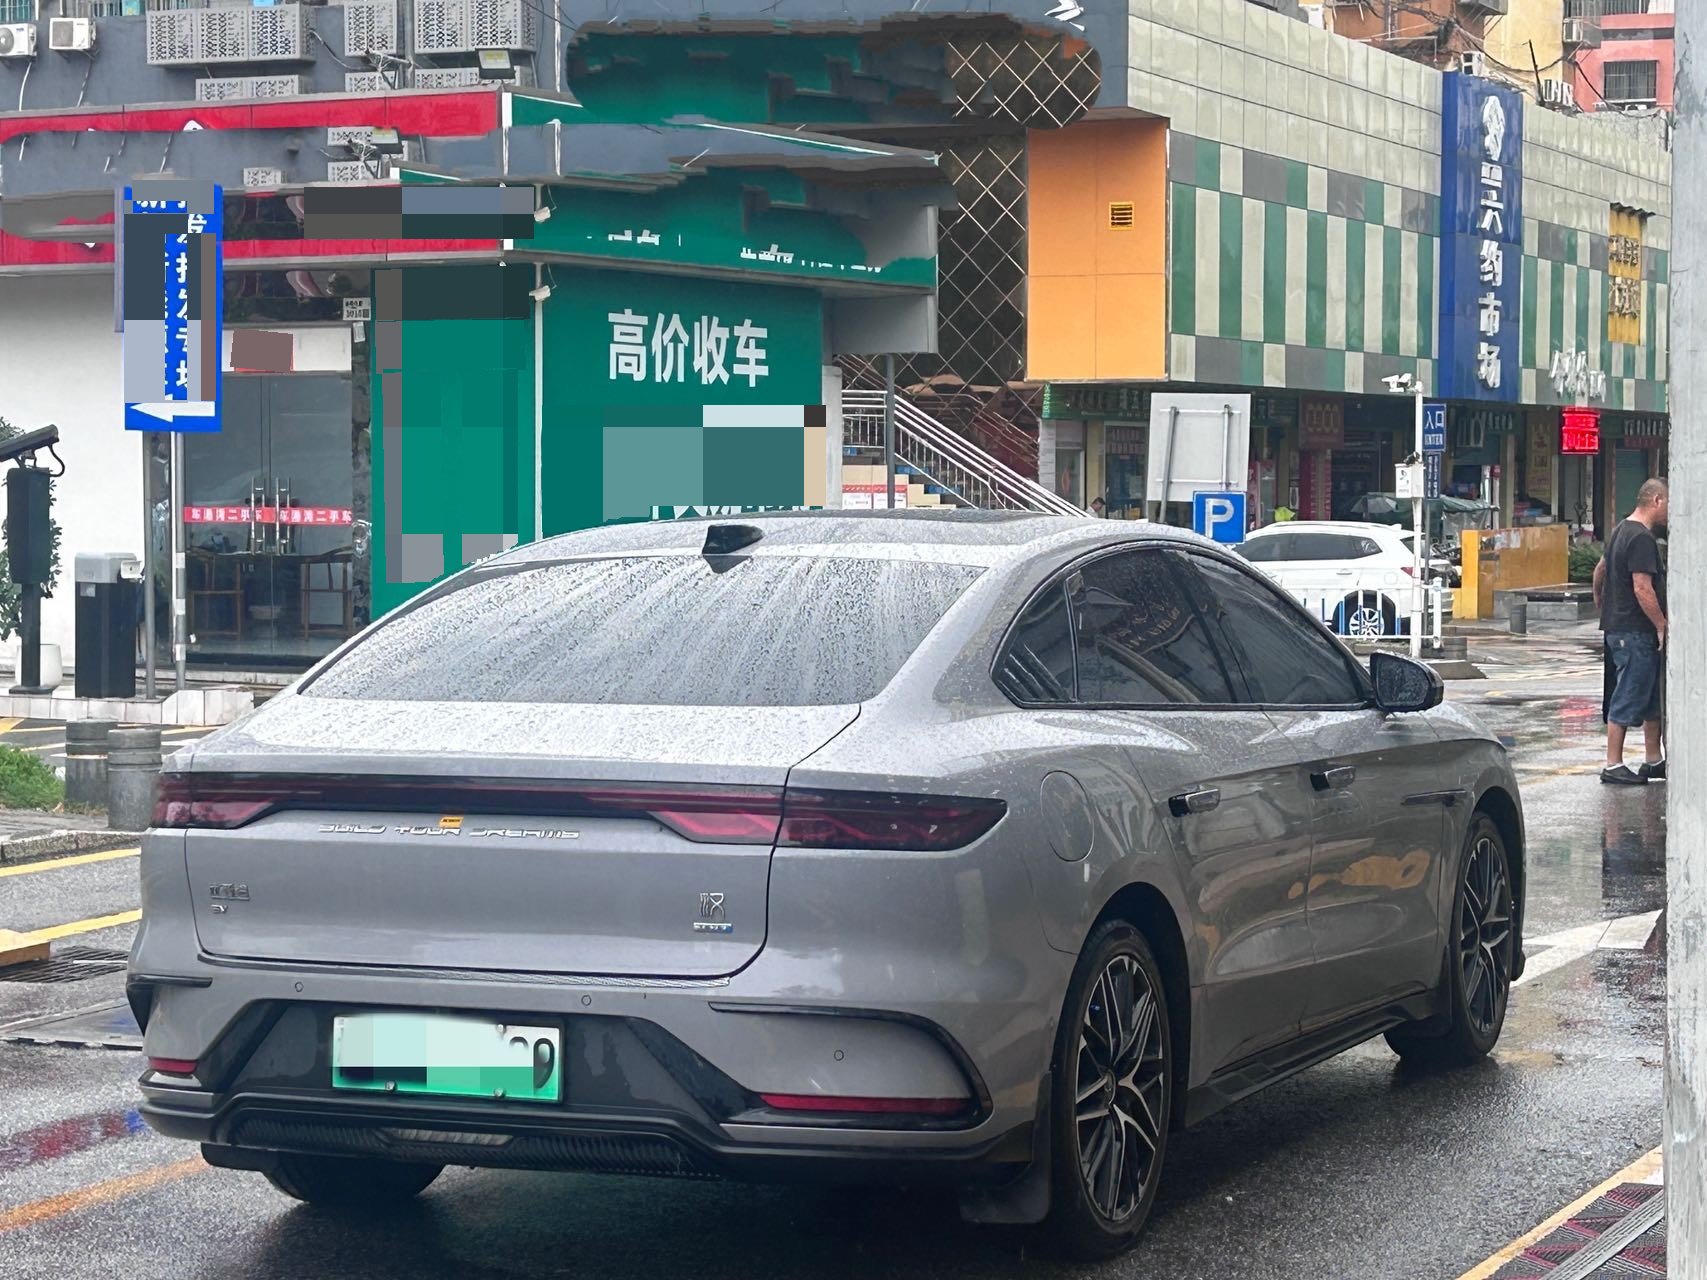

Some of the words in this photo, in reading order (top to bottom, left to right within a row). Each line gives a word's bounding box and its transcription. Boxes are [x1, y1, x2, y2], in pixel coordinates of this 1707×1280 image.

[608, 308, 769, 387] 高价收车
[1424, 410, 1444, 430] 入口
[1205, 498, 1234, 539] P
